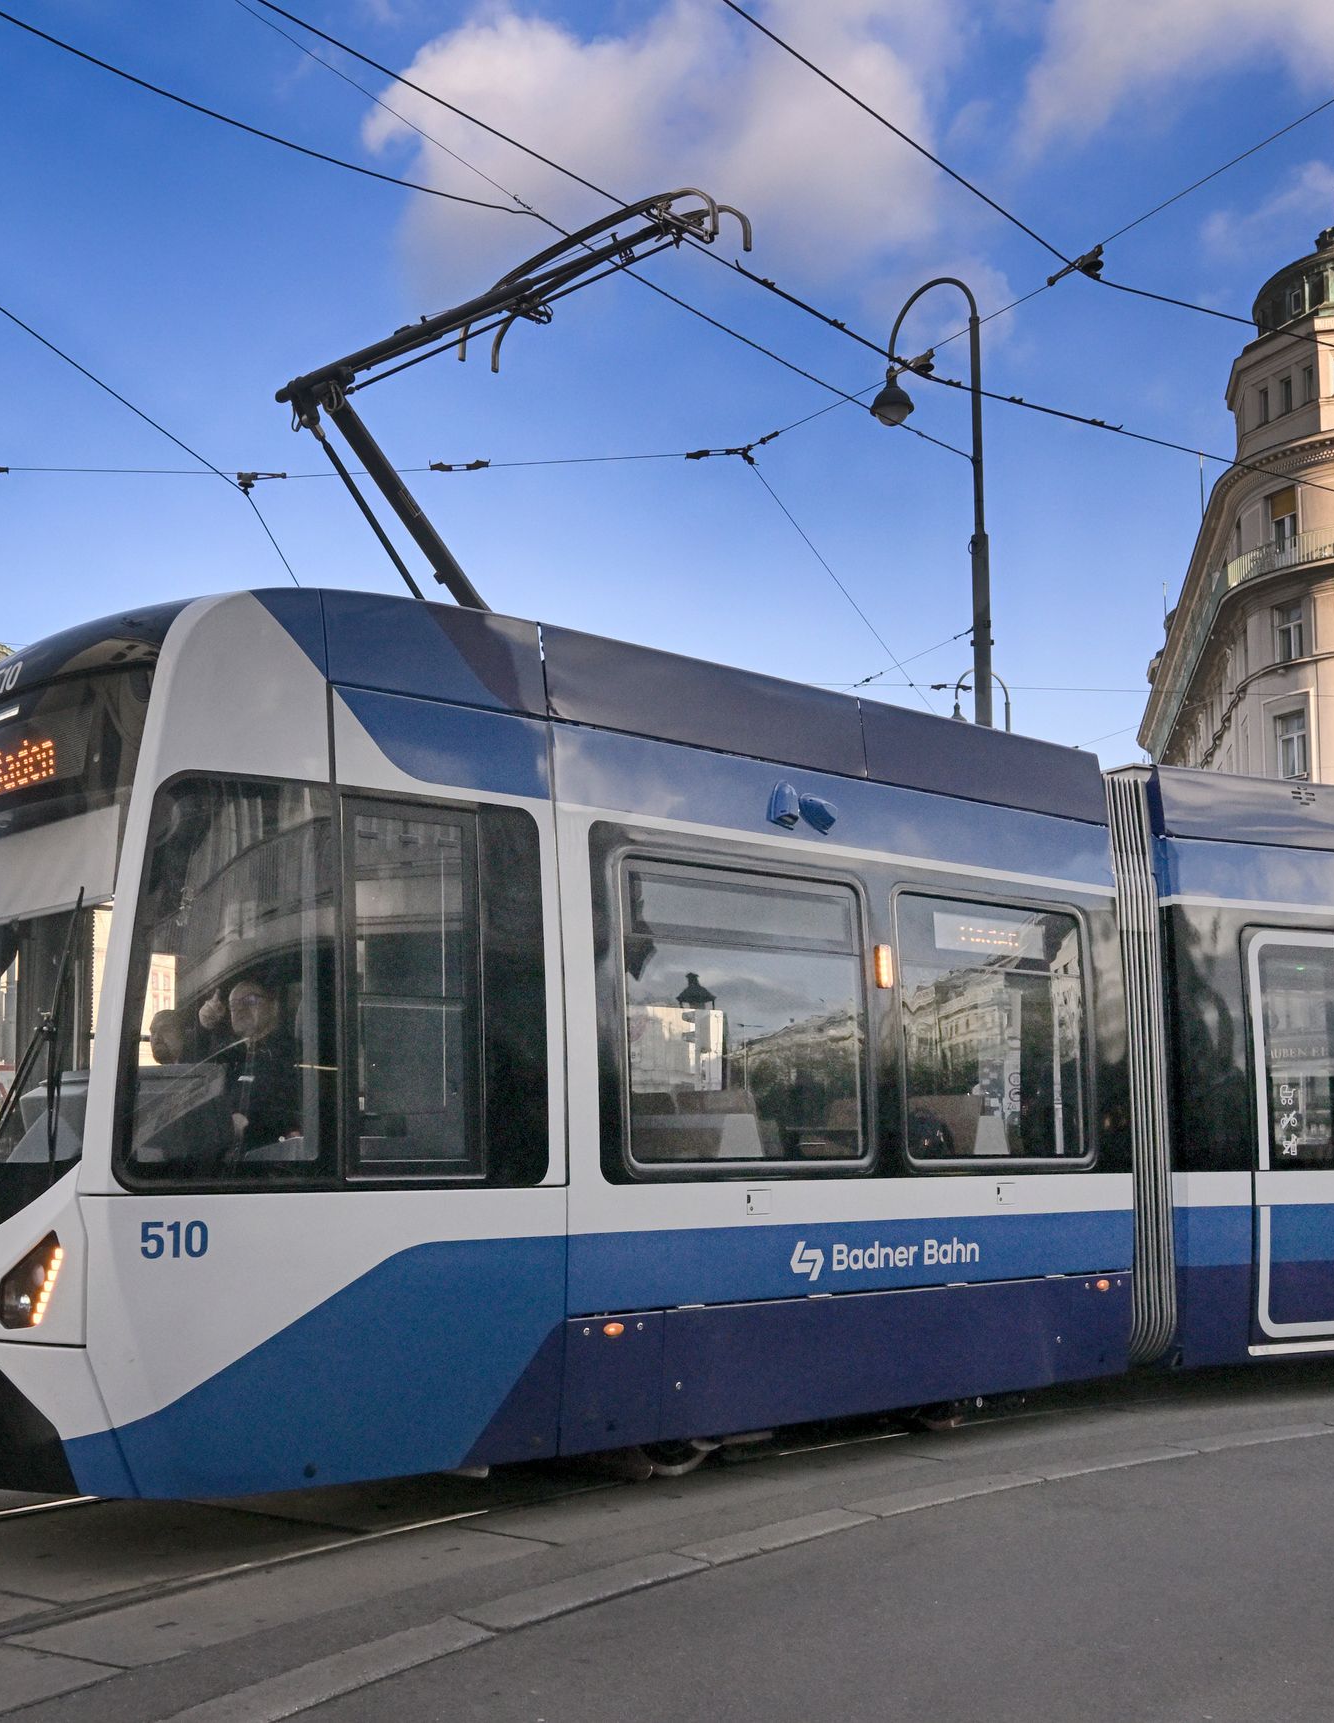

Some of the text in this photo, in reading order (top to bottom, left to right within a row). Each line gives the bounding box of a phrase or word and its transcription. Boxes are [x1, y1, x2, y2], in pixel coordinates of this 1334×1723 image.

[141, 1220, 208, 1259] 510
[832, 1237, 980, 1271] Badner Bahn
